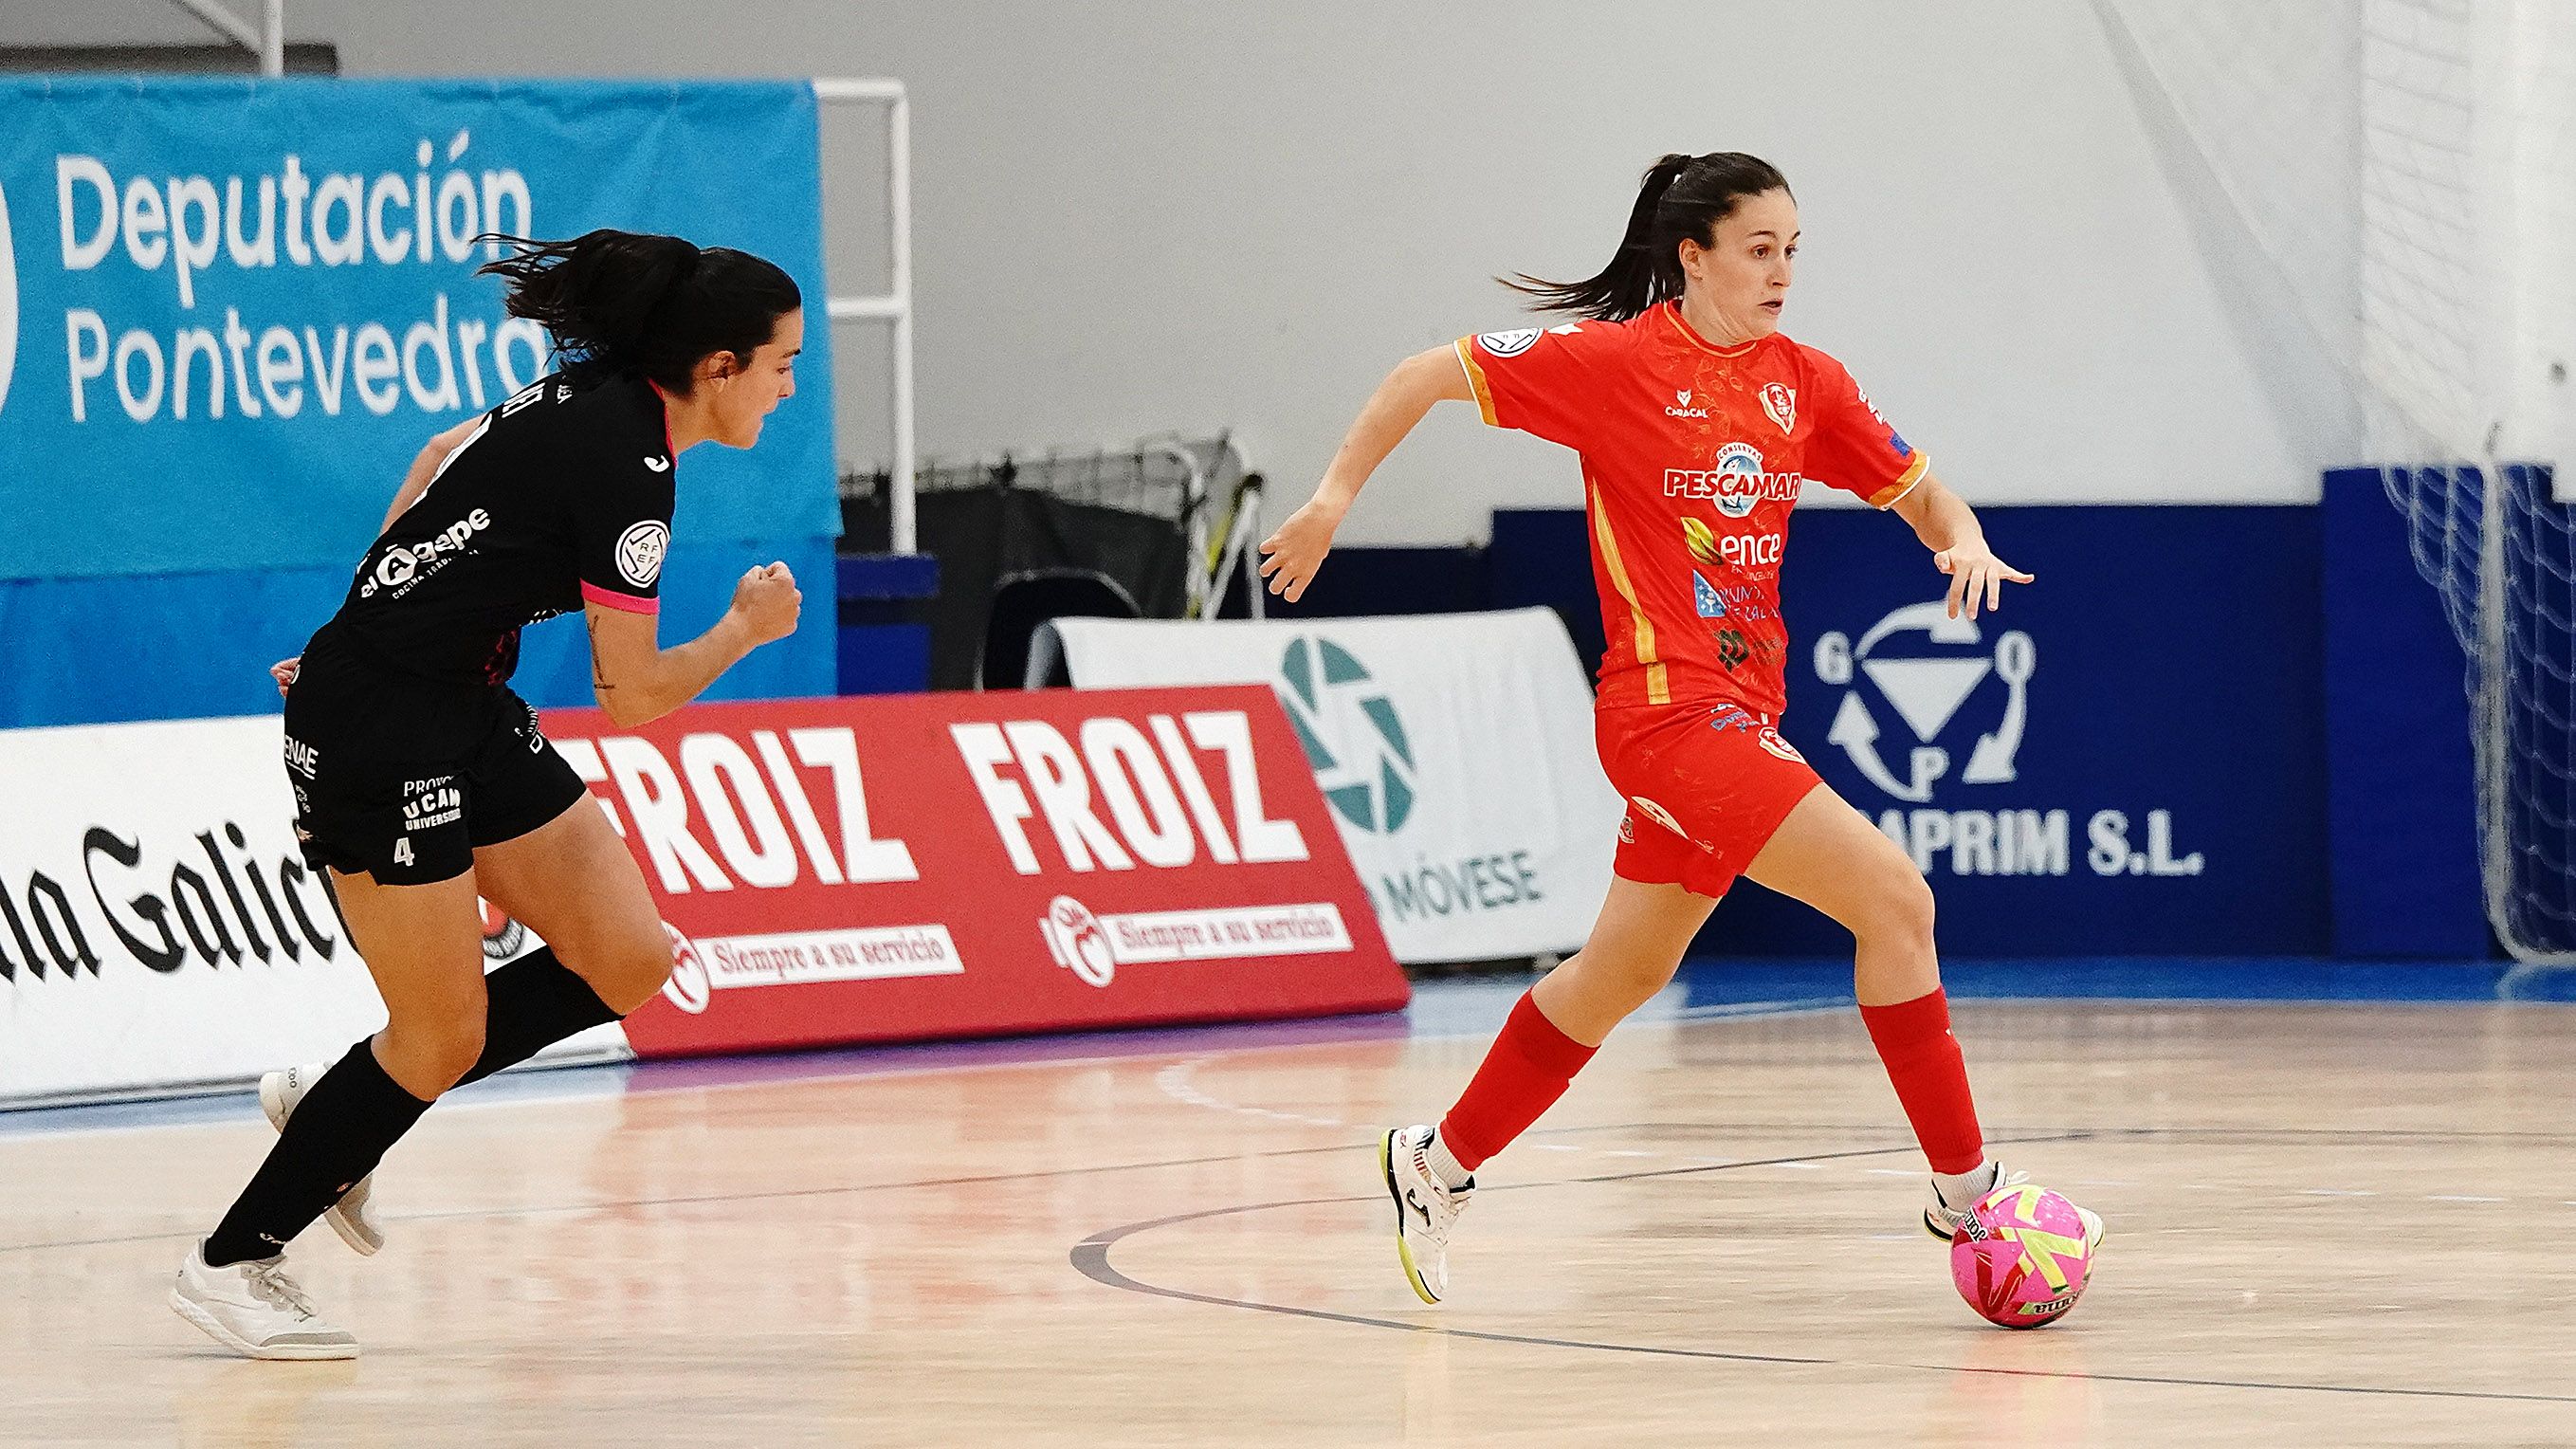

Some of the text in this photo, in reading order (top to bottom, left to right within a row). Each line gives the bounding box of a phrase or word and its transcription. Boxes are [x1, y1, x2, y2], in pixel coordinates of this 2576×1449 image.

[56, 129, 532, 307] Deputación
[1665, 406, 1708, 418] CARACAL
[1718, 444, 1763, 462] CONSERVAS
[1665, 470, 1800, 500] PESCAMAR
[1720, 533, 1781, 566] ence
[361, 575, 378, 598] el
[950, 709, 1308, 875] FROIZ
[393, 836, 414, 867] 4
[1858, 807, 2206, 877] APRIM S.L.
[1115, 908, 1336, 954] Siempre a su servicio
[712, 931, 946, 981] Siempre a su servicio
[1963, 1207, 1989, 1243] Jom
